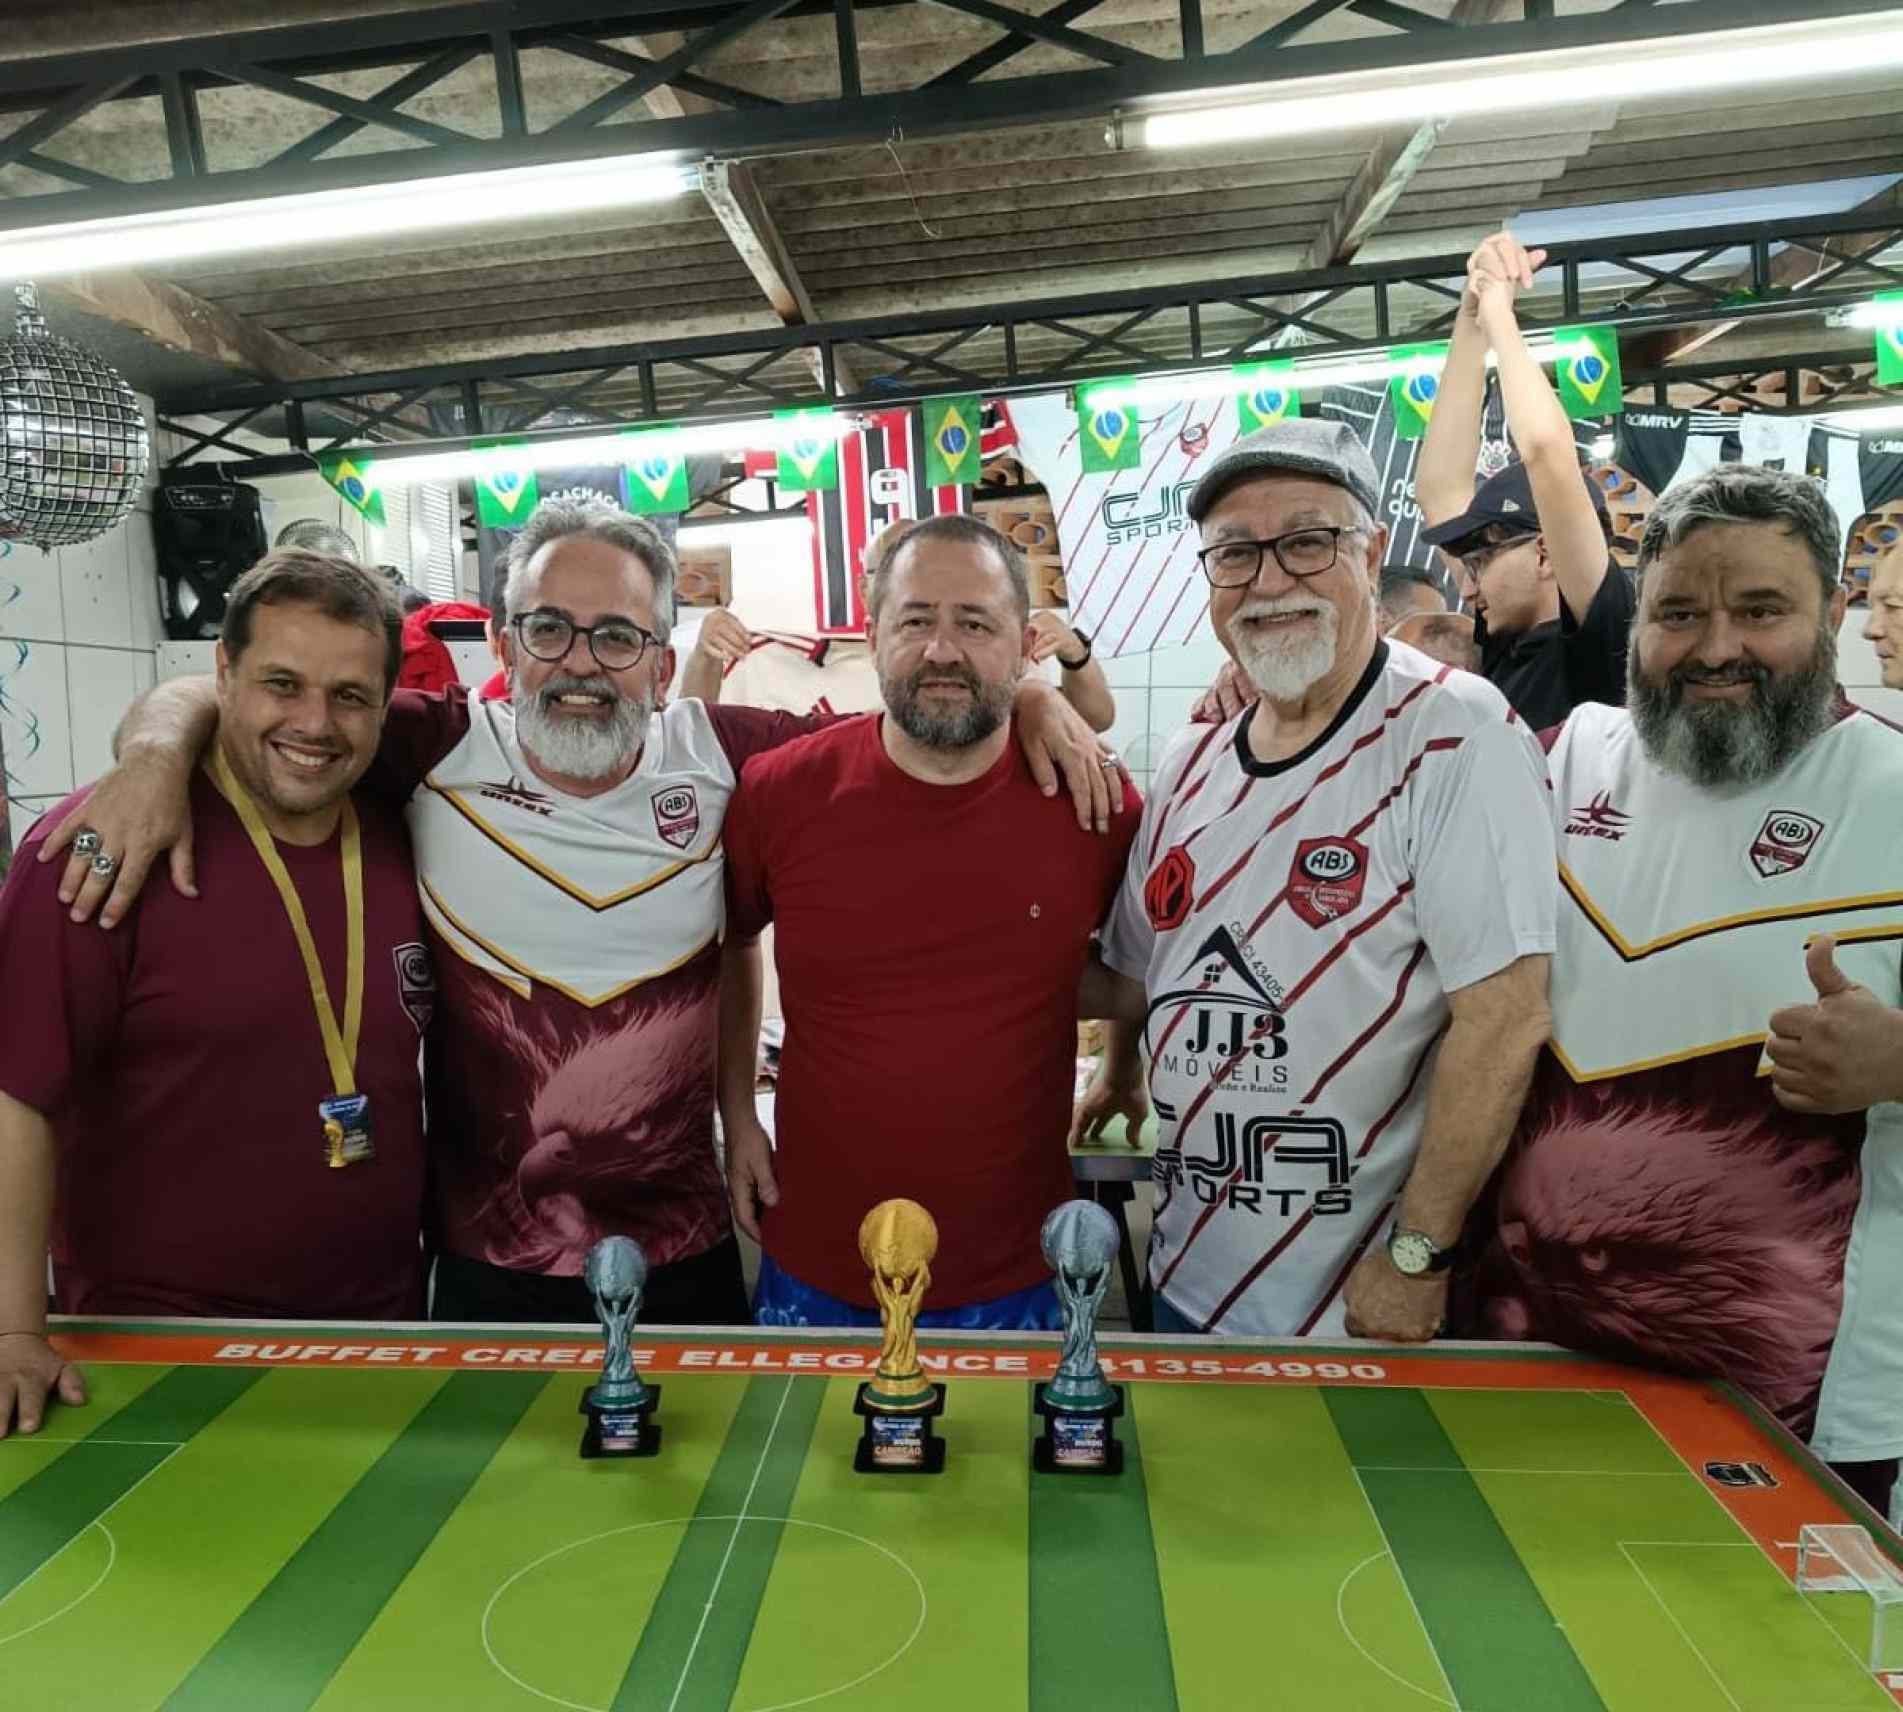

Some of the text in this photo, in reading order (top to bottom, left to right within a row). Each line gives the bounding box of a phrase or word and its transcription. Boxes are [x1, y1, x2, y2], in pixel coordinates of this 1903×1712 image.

[1640, 414, 1683, 429] MRV
[1106, 519, 1187, 545] SPOR
[1185, 1008, 1289, 1060] JJ3
[214, 1343, 446, 1361] BUFFET
[678, 1350, 1029, 1371] ELLEGNCE
